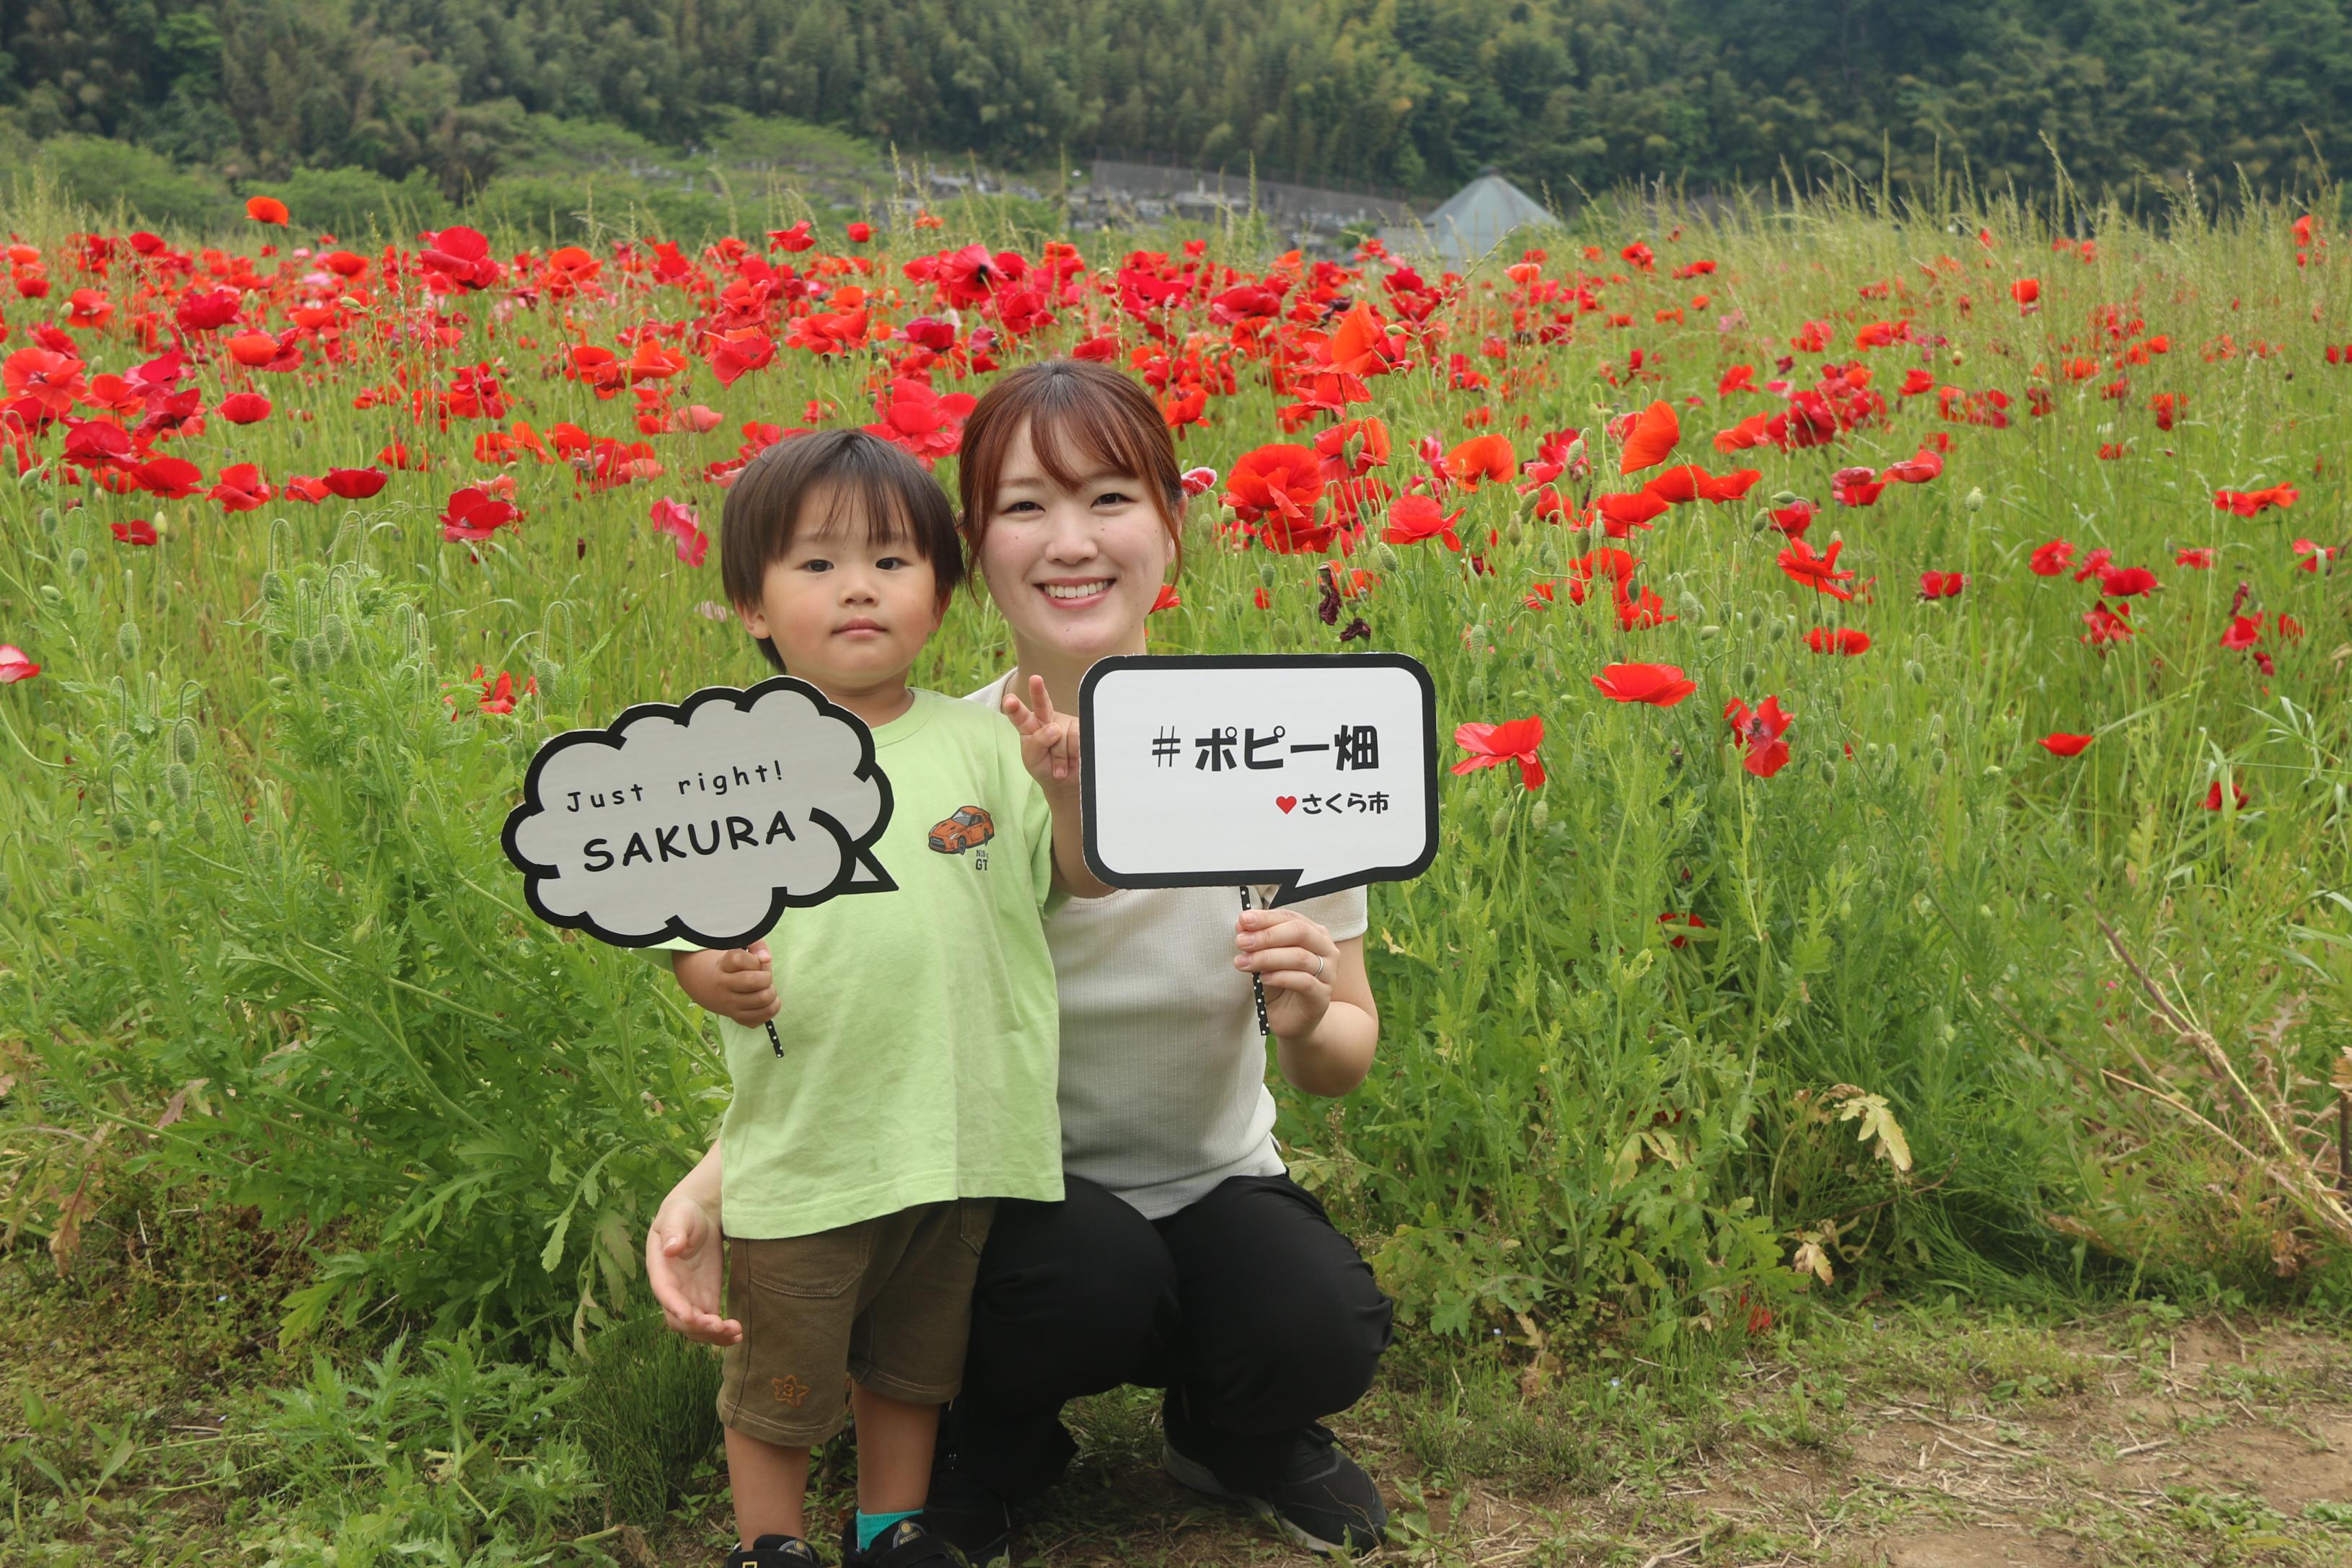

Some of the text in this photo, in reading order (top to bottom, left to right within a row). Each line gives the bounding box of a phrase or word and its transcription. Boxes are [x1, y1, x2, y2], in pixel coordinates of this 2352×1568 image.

[567, 759, 783, 813] Just right!
[1302, 791, 1390, 814] さくら市
[583, 810, 796, 873] SAKURA
